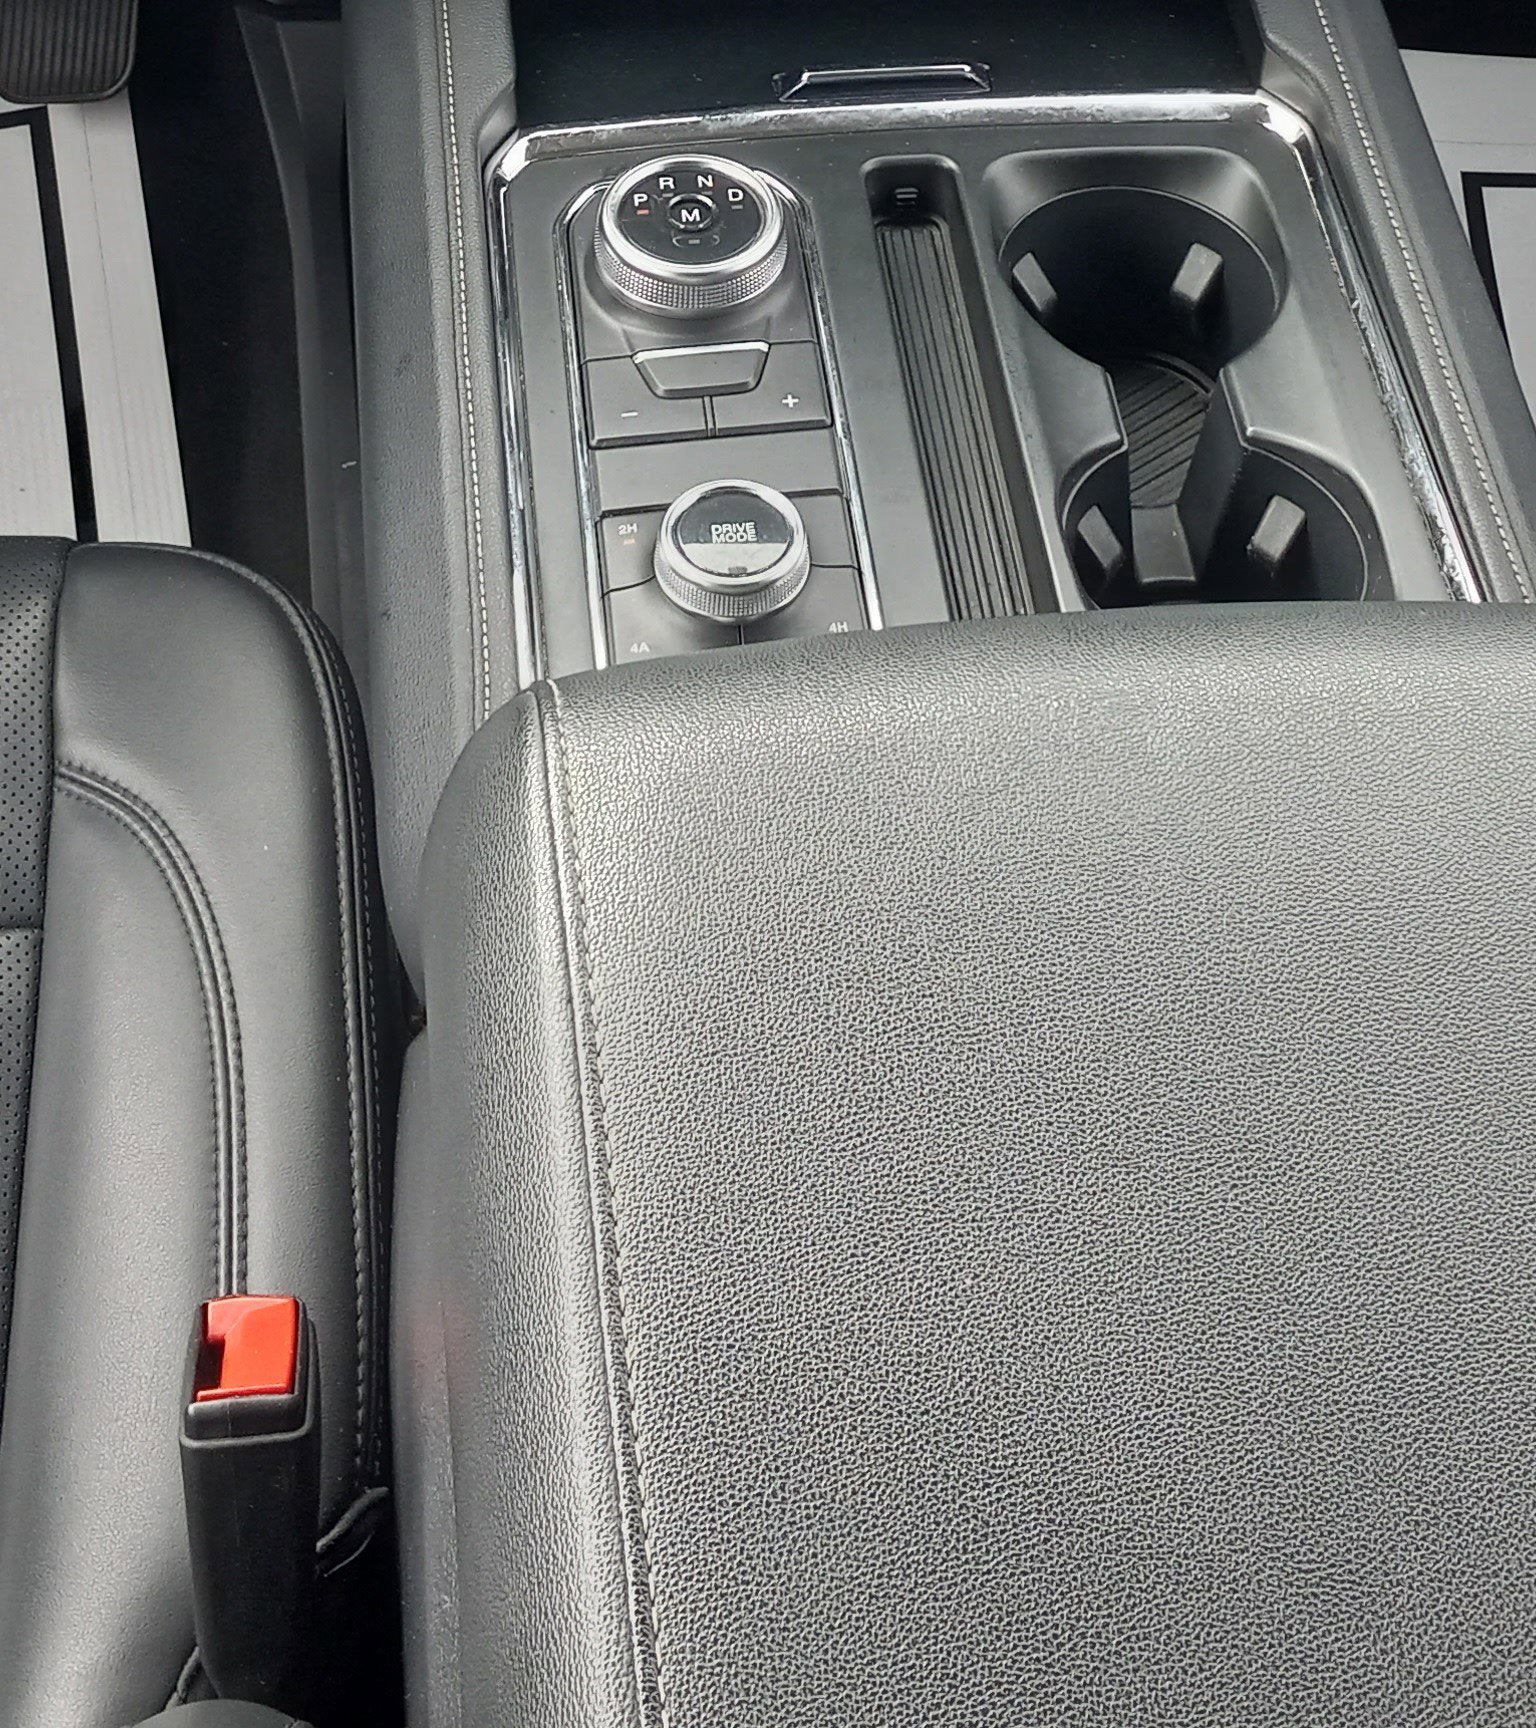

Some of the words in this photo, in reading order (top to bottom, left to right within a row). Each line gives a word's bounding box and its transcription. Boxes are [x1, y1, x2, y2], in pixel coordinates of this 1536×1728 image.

[659, 176, 675, 191] R
[696, 174, 714, 189] N
[632, 192, 648, 209] P
[727, 188, 745, 203] D
[680, 208, 702, 223] M
[617, 522, 638, 535] 2H
[710, 522, 756, 535] DRIVE
[711, 532, 758, 544] MODE
[828, 621, 849, 633] 4H
[629, 641, 651, 653] 4A
